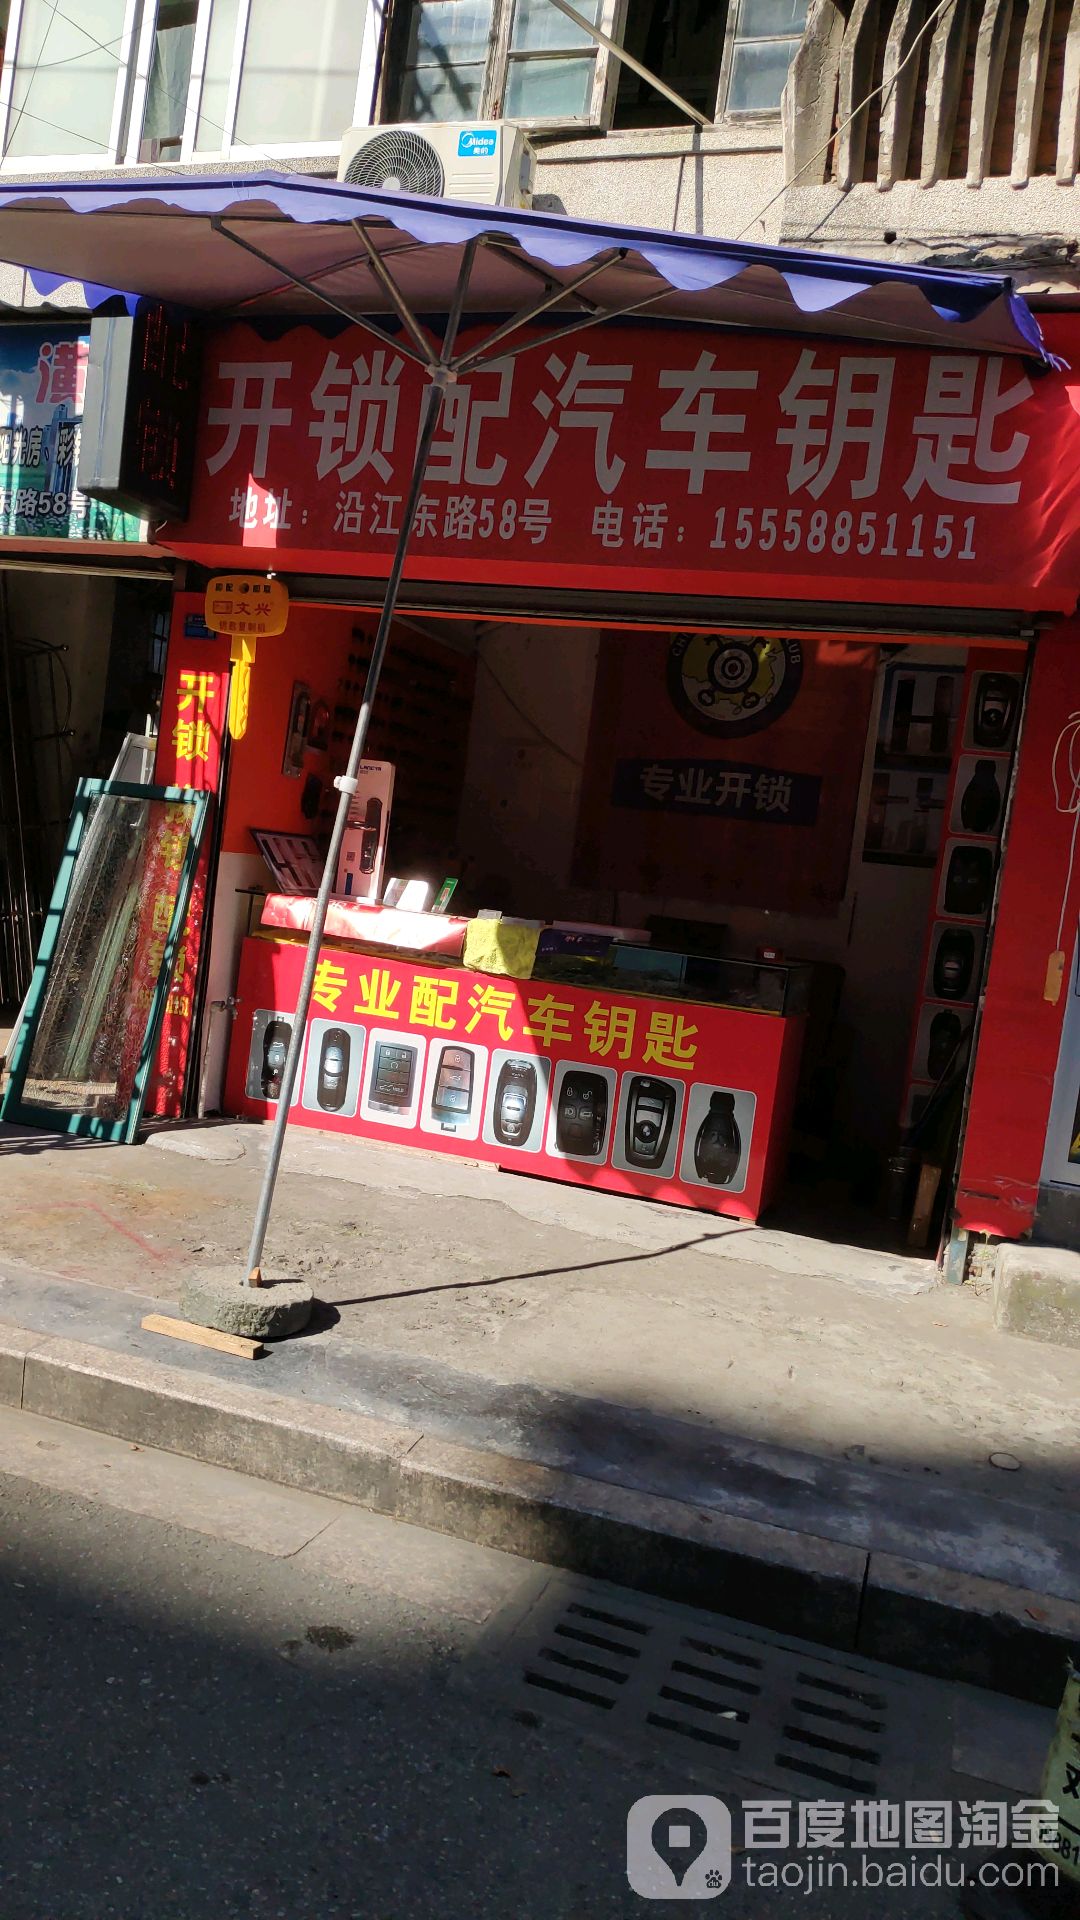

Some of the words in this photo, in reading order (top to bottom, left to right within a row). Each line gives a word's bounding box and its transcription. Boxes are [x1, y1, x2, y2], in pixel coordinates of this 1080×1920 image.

[466, 137, 494, 146] Midea
[205, 349, 1035, 505] 开锁配汽车钥匙
[333, 491, 552, 545] 沿江东路58号
[709, 506, 977, 560] 15558851151
[234, 601, 272, 616] 文兴
[171, 673, 215, 761] 开锁
[640, 764, 793, 814] 专业开锁
[312, 959, 699, 1071] 专业配汽车钥匙
